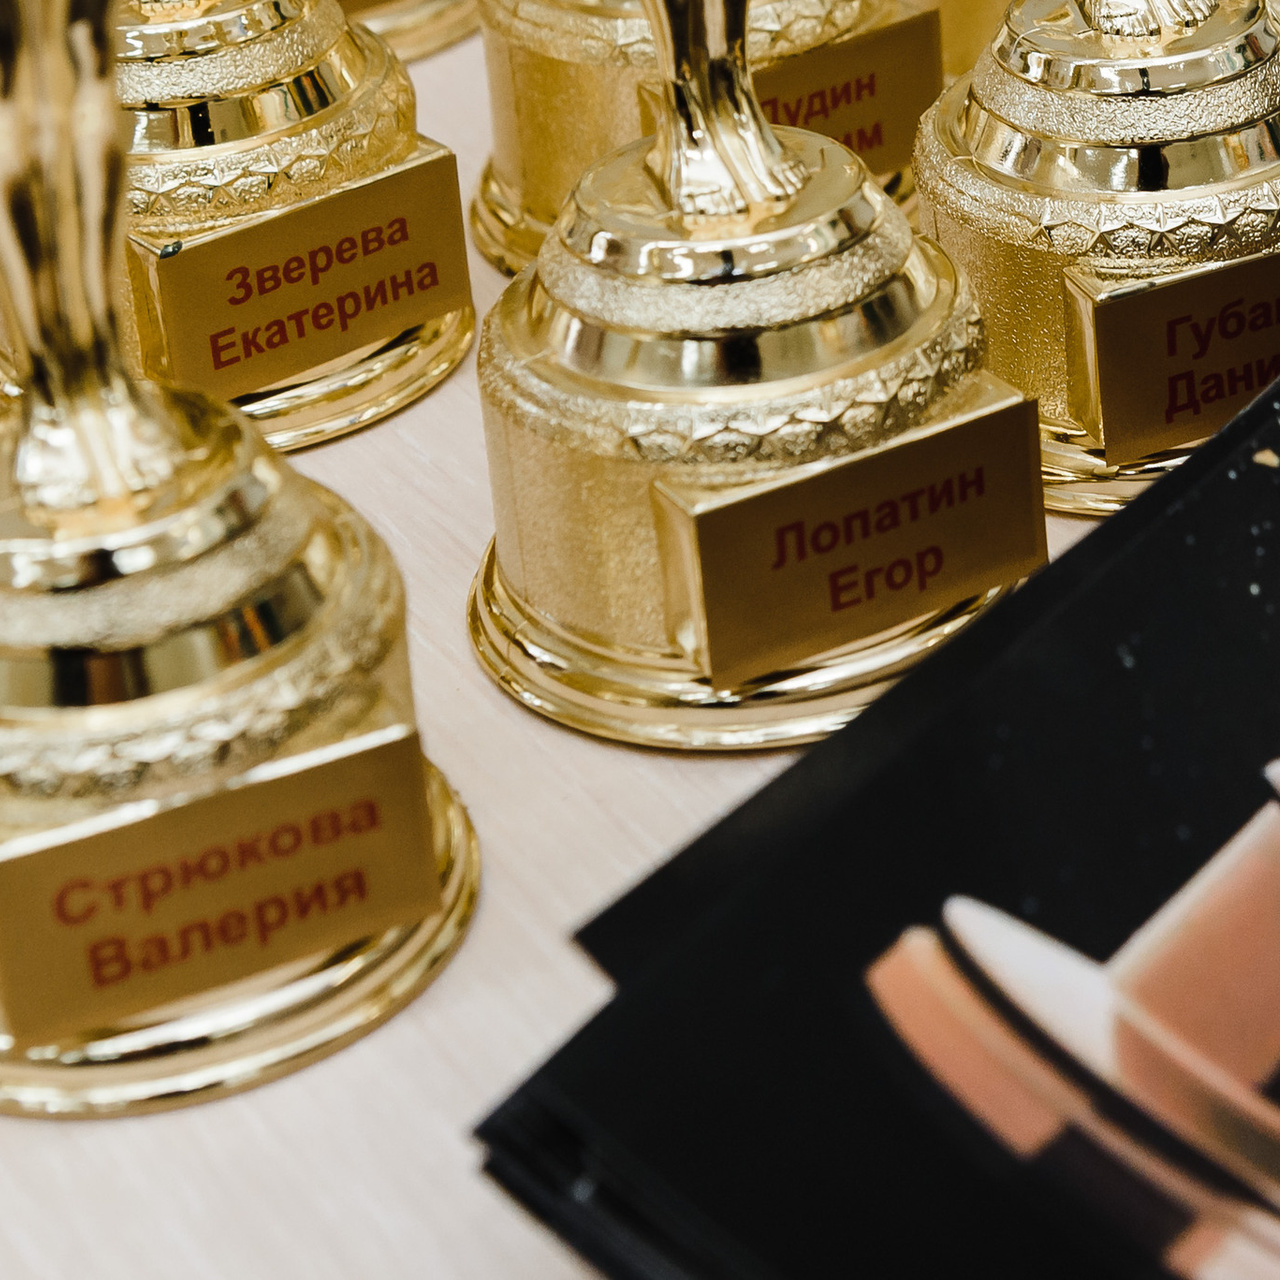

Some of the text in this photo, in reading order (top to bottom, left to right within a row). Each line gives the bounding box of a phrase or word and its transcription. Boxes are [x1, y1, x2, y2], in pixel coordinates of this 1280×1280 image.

[225, 216, 409, 305] Зверева
[209, 261, 439, 371] Екатерина
[772, 467, 985, 570] Лопатин
[828, 545, 944, 612] Егор
[53, 797, 381, 926] Стрюкова
[87, 868, 368, 989] Валерия
